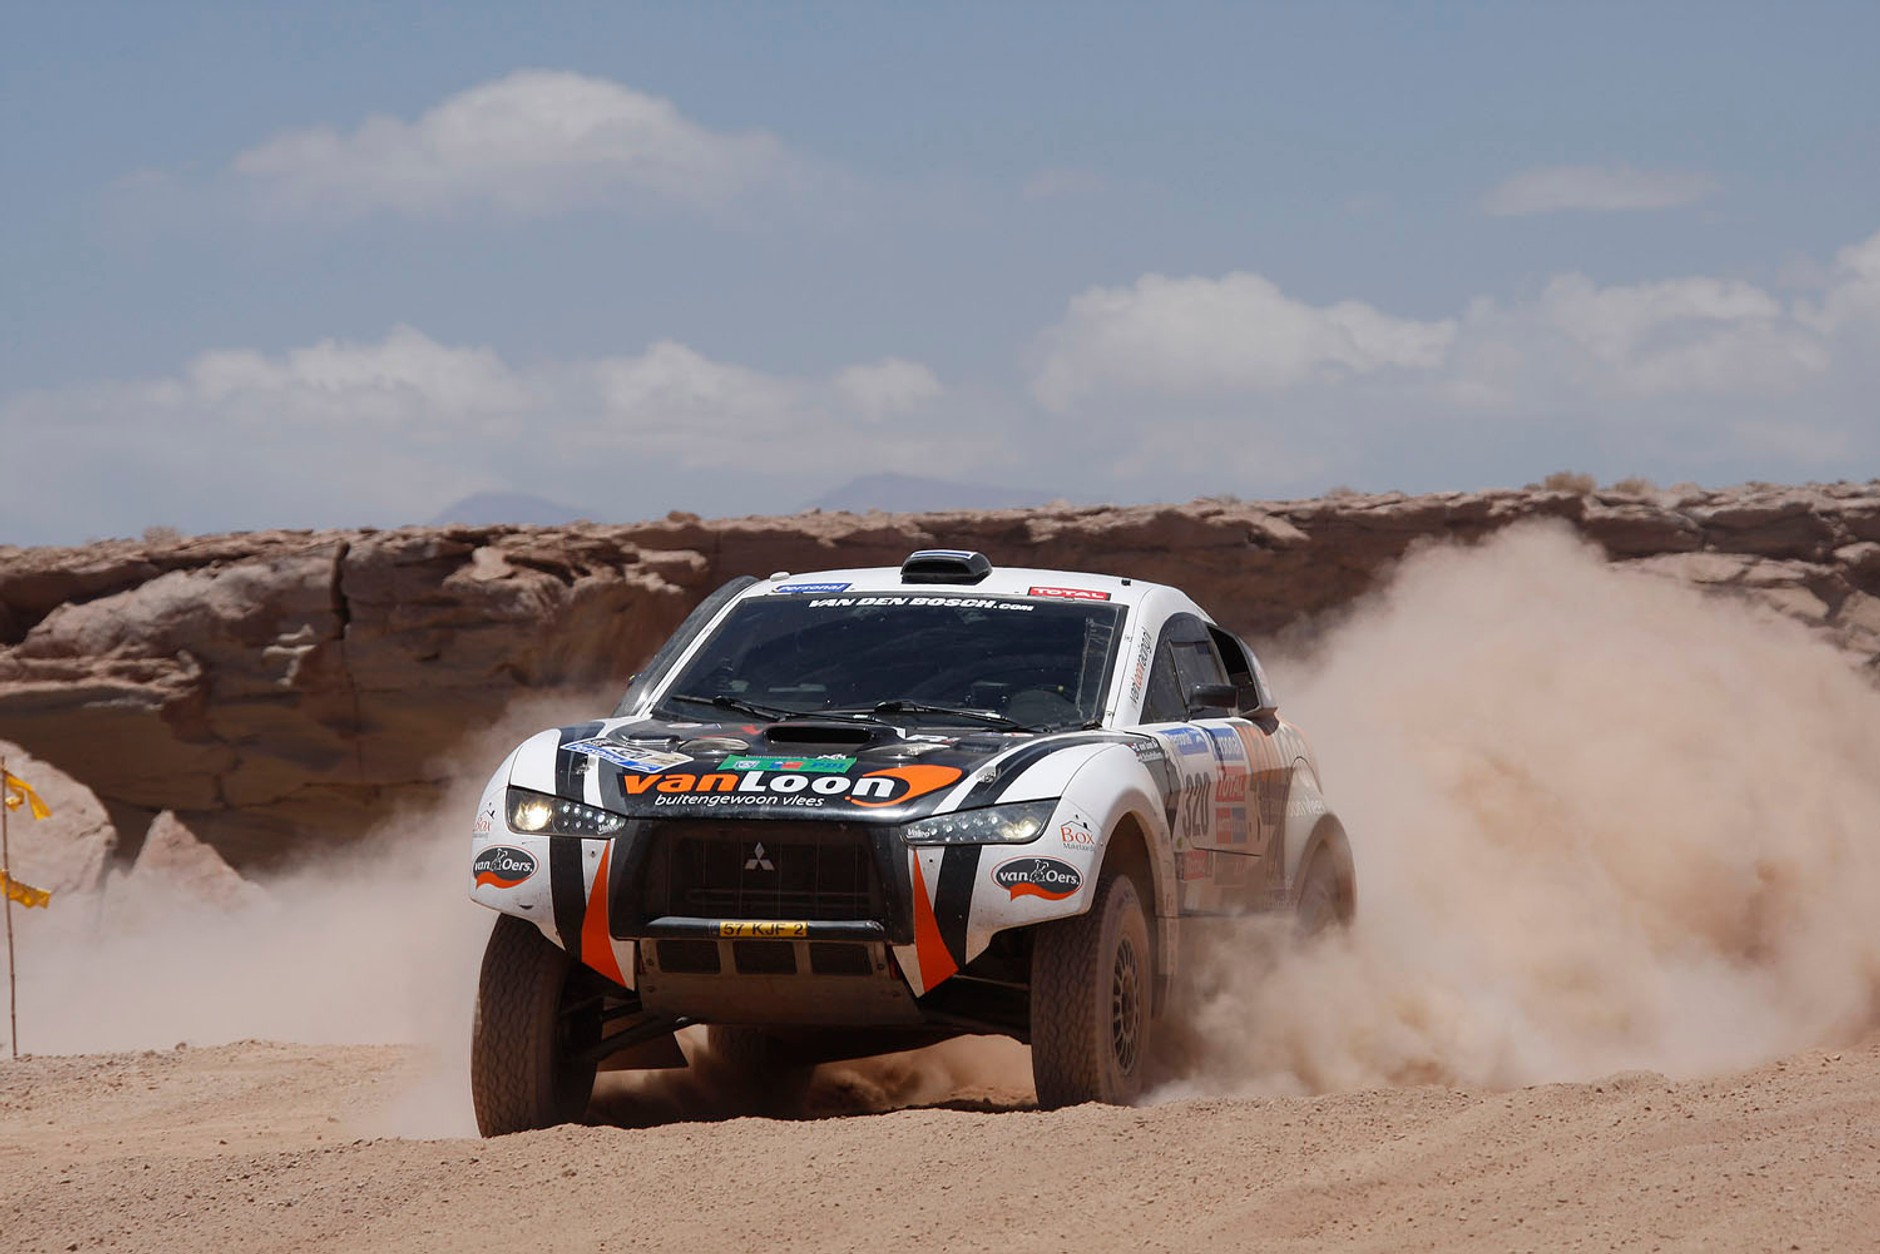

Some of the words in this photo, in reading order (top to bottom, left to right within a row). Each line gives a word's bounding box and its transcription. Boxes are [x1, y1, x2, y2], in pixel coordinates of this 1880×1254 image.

[1033, 587, 1105, 599] TOTAL
[809, 598, 855, 608] VAN
[856, 597, 908, 606] DEN
[655, 793, 778, 807] buitengewoon
[782, 794, 825, 807] vlees
[1182, 771, 1212, 839] 320
[1061, 826, 1095, 845] Box
[1000, 871, 1028, 882] van
[723, 923, 744, 935] 57
[752, 923, 786, 935] KJF
[794, 923, 804, 935] 2
